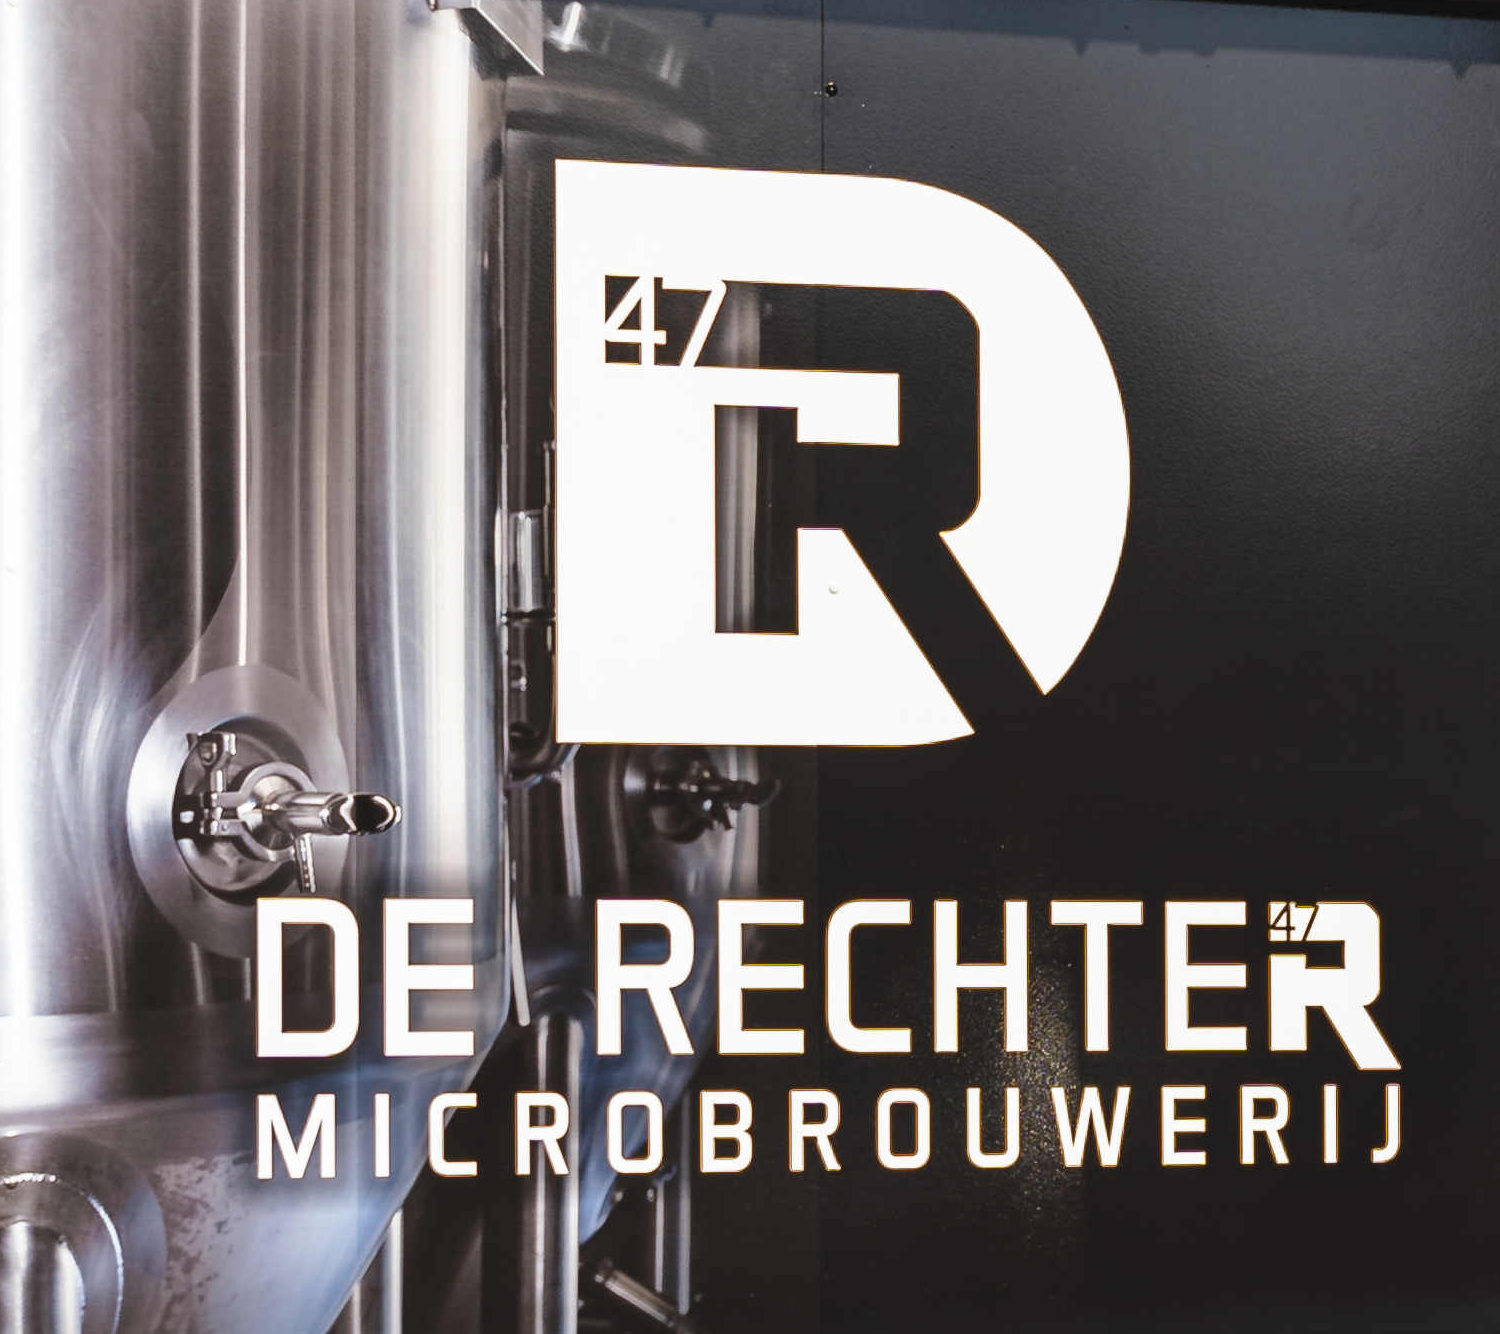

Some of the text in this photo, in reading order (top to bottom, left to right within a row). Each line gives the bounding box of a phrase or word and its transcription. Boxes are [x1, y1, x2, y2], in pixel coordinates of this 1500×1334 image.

[604, 274, 728, 367] 47
[256, 897, 1402, 1070] DE RECHTER
[256, 1084, 1401, 1180] MICROBROUWERIJ
